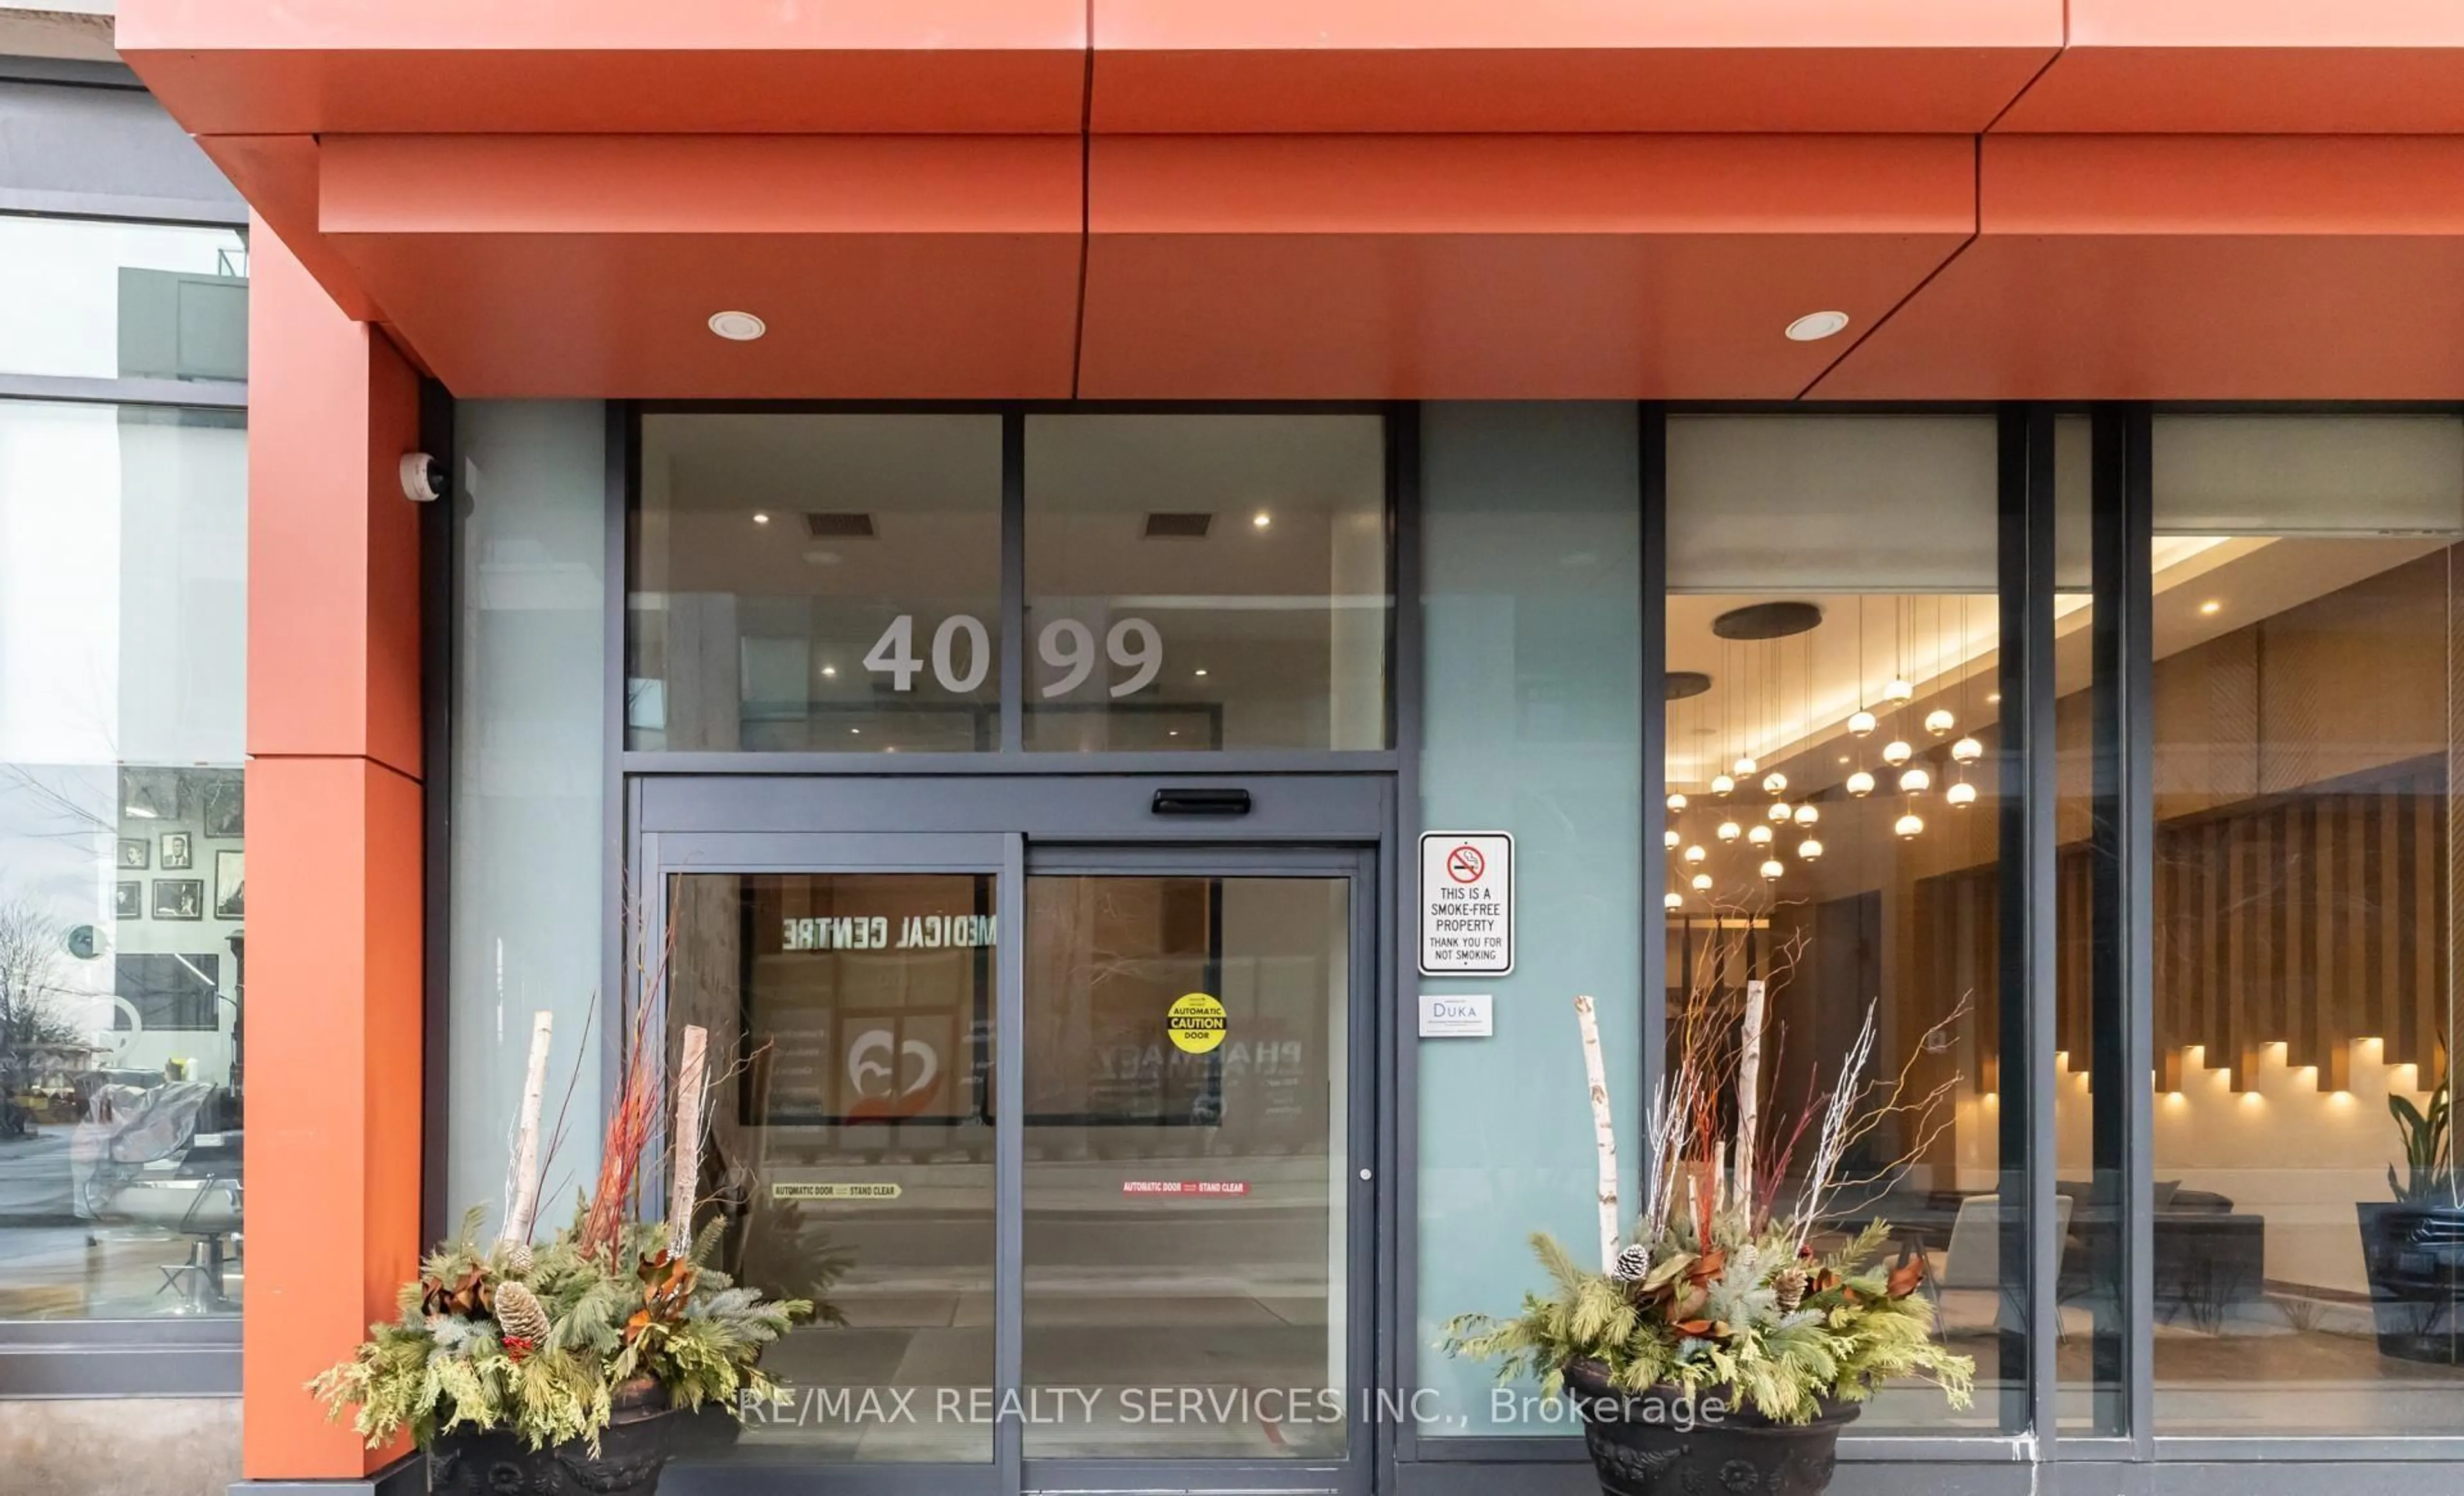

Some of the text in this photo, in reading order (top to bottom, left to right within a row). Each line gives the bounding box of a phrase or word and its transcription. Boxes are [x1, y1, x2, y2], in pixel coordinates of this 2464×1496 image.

[1441, 888, 1491, 899] THIS IS A
[1431, 903, 1500, 915] SMOKE-FREE
[1436, 919, 1494, 931] PROPERTY
[1430, 937, 1502, 948] THANK YOU FOR
[1435, 950, 1496, 960] NOT SMOKING
[1433, 1003, 1477, 1017] DUKA
[1170, 1017, 1223, 1029] CAUTION
[775, 1186, 813, 1196] AUTOMATIC
[815, 1186, 834, 1196] DOOR
[850, 1186, 872, 1196] STAND
[873, 1186, 894, 1196] CLEAR
[1123, 1182, 1161, 1192] AUTOMATIC
[1163, 1182, 1181, 1192] DOOR
[1199, 1182, 1221, 1192] STAND
[1222, 1182, 1244, 1192] CLEAR
